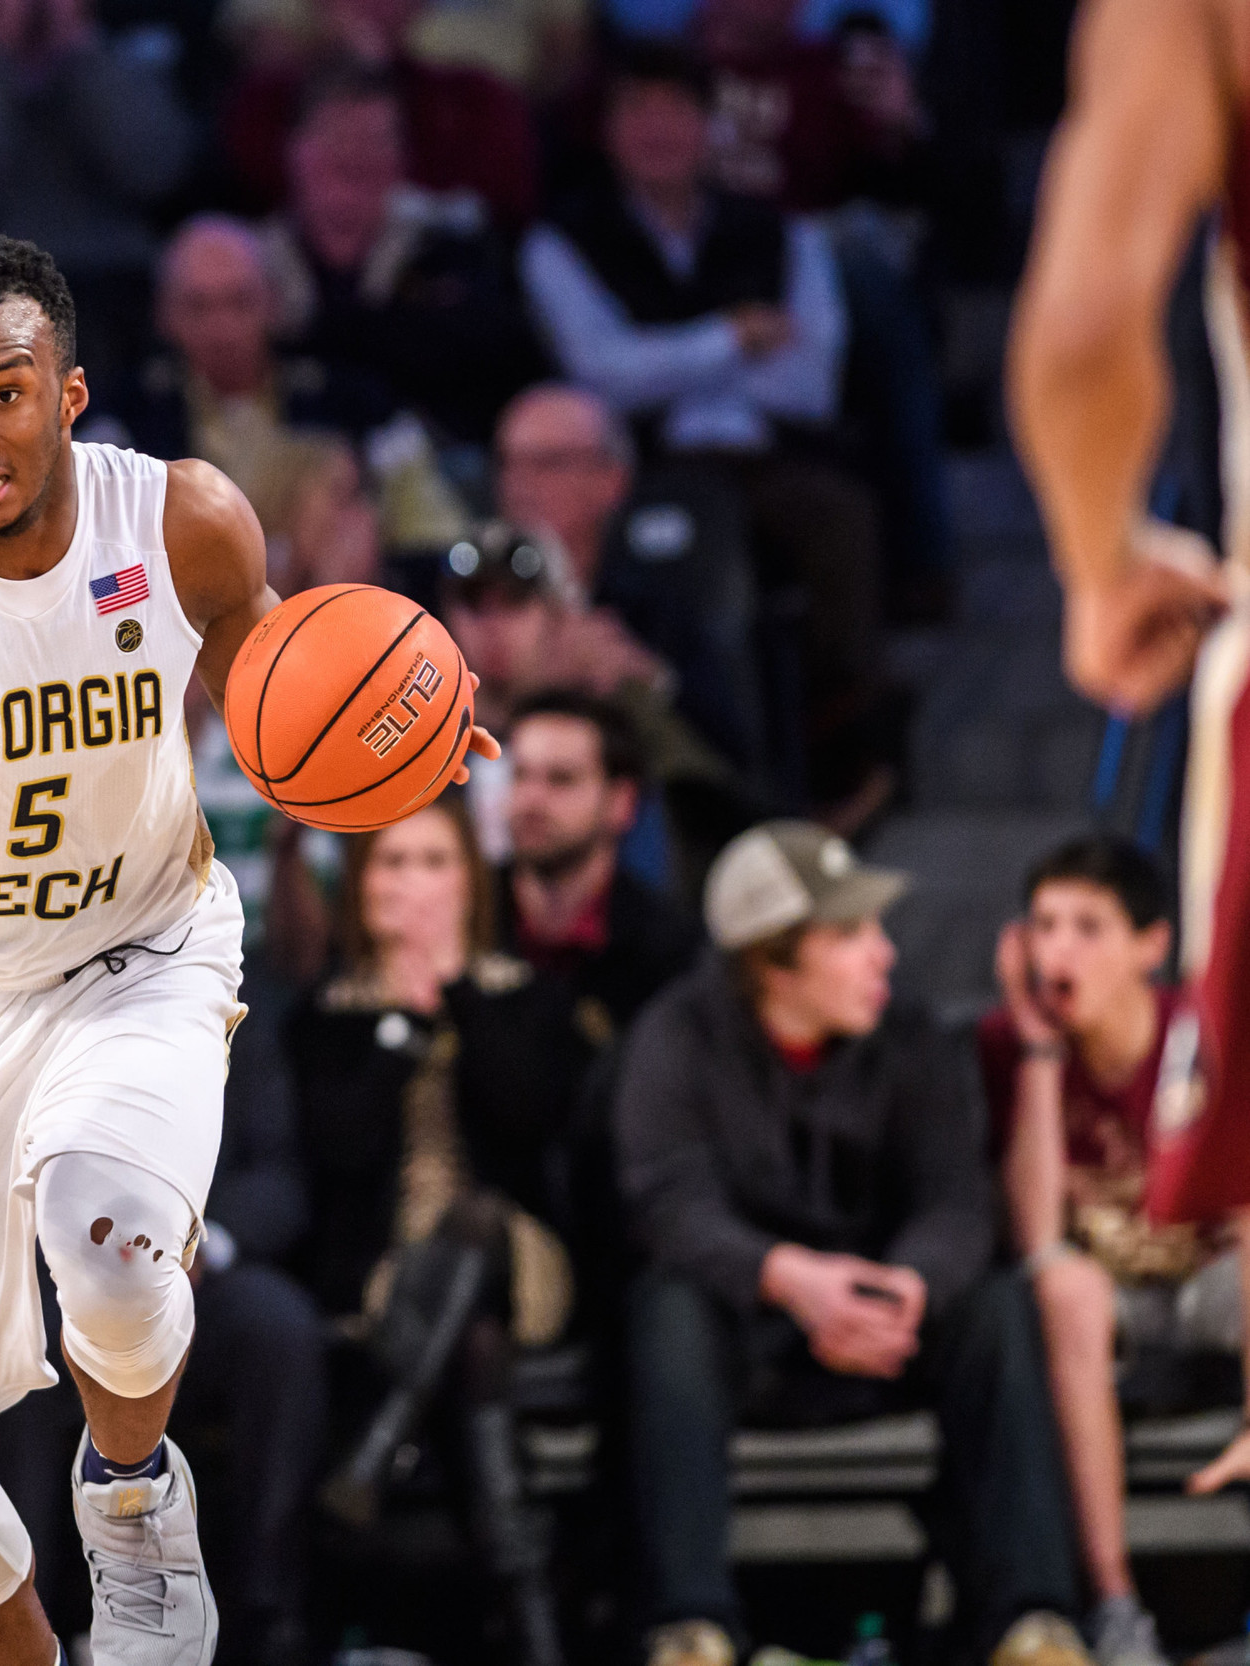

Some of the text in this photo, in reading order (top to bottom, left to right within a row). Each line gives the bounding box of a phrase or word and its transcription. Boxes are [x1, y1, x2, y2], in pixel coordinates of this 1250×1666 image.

[356, 651, 424, 738] CHAMPIONSHIP
[362, 658, 444, 759] ELITE
[6, 773, 71, 861] 5
